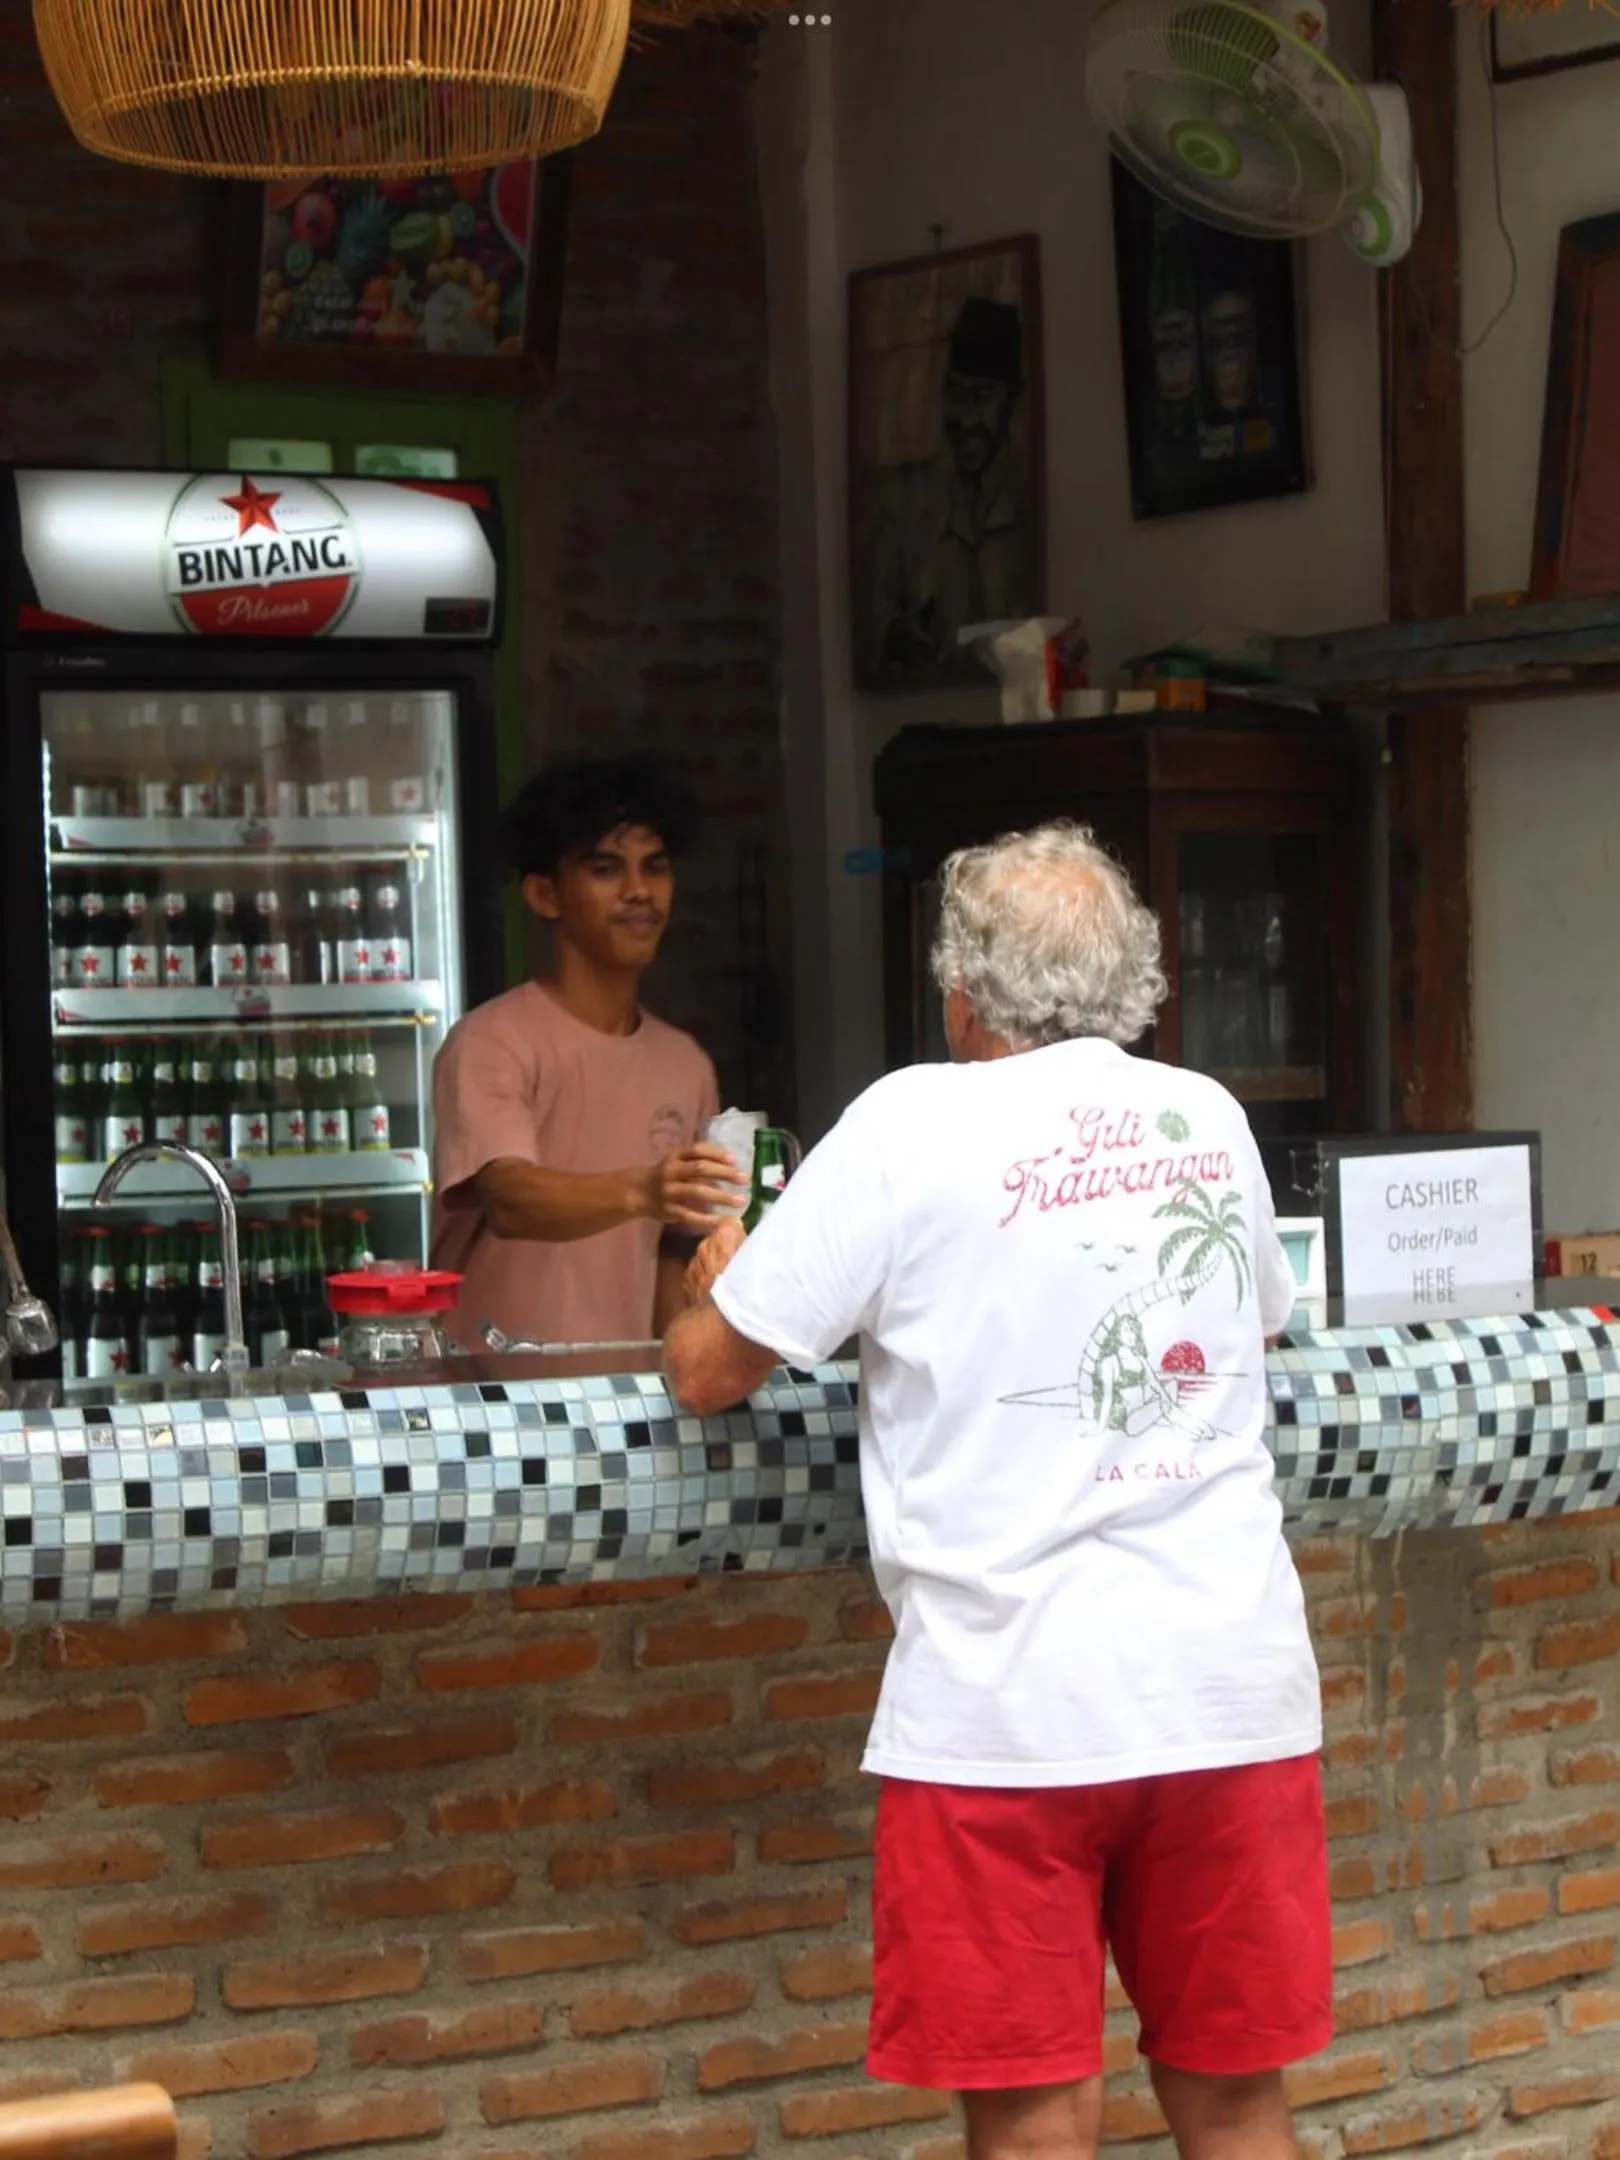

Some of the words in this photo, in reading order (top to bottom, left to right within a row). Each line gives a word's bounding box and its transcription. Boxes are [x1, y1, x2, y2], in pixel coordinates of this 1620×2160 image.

[178, 535, 347, 586] BINTANG
[217, 594, 311, 624] Pilsener
[1068, 1106, 1147, 1164] Gili
[998, 1147, 1235, 1229] Trawangan
[1385, 1177, 1479, 1210] CASHIER
[1387, 1225, 1478, 1252] Order/Paid
[1412, 1265, 1456, 1288] HERE
[1094, 1464, 1124, 1482] LA
[1133, 1462, 1203, 1480] CALA
